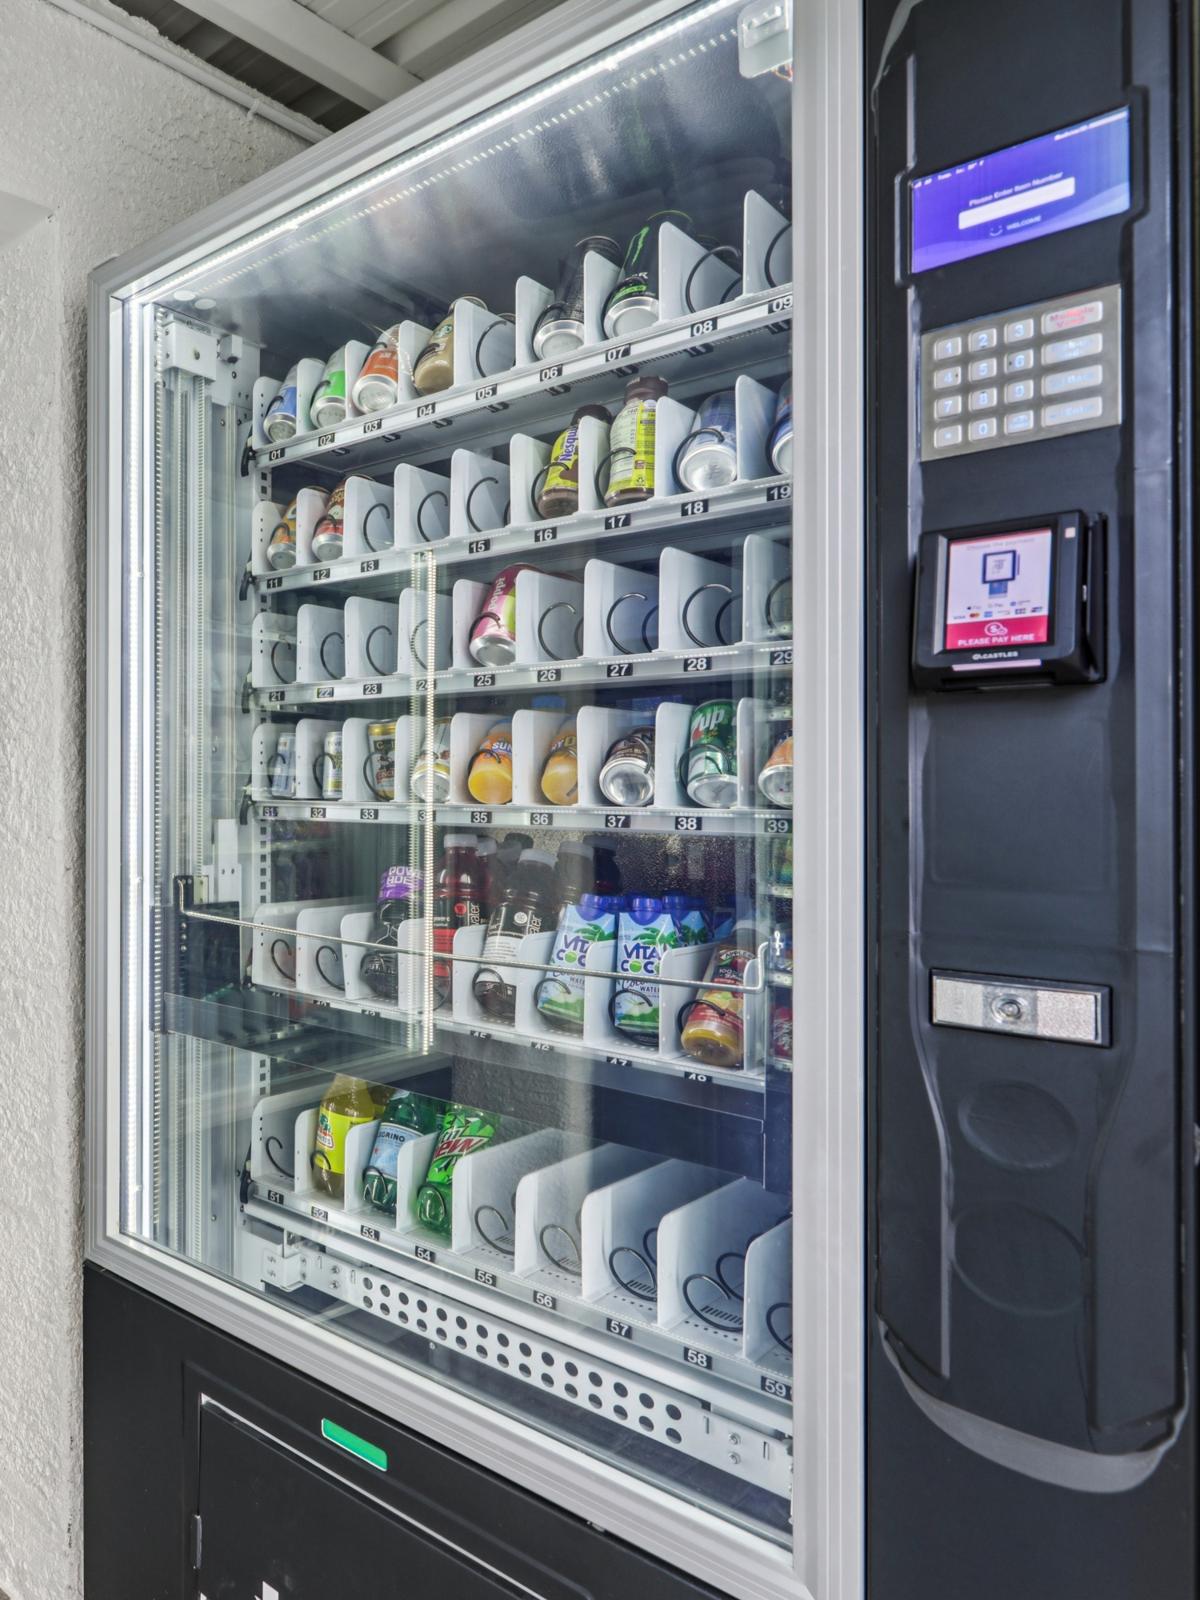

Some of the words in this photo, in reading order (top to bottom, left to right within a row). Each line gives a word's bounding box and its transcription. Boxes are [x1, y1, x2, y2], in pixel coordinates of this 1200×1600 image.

[772, 296, 792, 312] 09
[693, 321, 713, 336] 08
[1014, 325, 1024, 338] 3
[978, 335, 988, 347] 2
[608, 347, 625, 361] 07
[946, 342, 953, 354] 1
[1015, 356, 1024, 368] 6
[542, 367, 558, 380] 06
[478, 388, 492, 399] 05
[419, 406, 434, 417] 04
[944, 402, 953, 413] 7
[365, 422, 378, 432] 03
[320, 436, 331, 446] 02
[271, 451, 282, 460] 01
[770, 486, 791, 500] 19
[684, 502, 704, 515] 18
[608, 516, 626, 528] 17
[536, 530, 553, 542] 16
[470, 540, 486, 553] 15
[362, 561, 374, 572] 13
[315, 570, 327, 580] 12
[268, 579, 278, 588] 11
[958, 638, 989, 647] PLEASE
[992, 636, 1008, 644] PAY
[1010, 634, 1035, 642] HERE
[774, 651, 793, 664] 29
[610, 664, 628, 676] 27
[688, 658, 708, 670] 28
[477, 675, 492, 686] 25
[540, 670, 556, 681] 26
[318, 688, 331, 698] 22
[364, 684, 379, 695] 23
[271, 692, 282, 701] 21
[312, 808, 324, 818] 32
[362, 810, 375, 820] 33
[472, 812, 488, 824] 35
[532, 814, 549, 826] 36
[608, 816, 626, 828] 37
[677, 817, 697, 830] 38
[768, 820, 788, 832] 39
[624, 942, 661, 960] VITA
[556, 948, 586, 967] COC
[270, 1192, 281, 1202] 51
[312, 1208, 325, 1219] 52
[362, 1226, 375, 1238] 53
[417, 1248, 432, 1260] 54
[478, 1272, 494, 1286] 55
[536, 1293, 553, 1308] 56
[610, 1321, 629, 1337] 57
[687, 1350, 708, 1368] 58
[764, 1378, 787, 1398] 59
